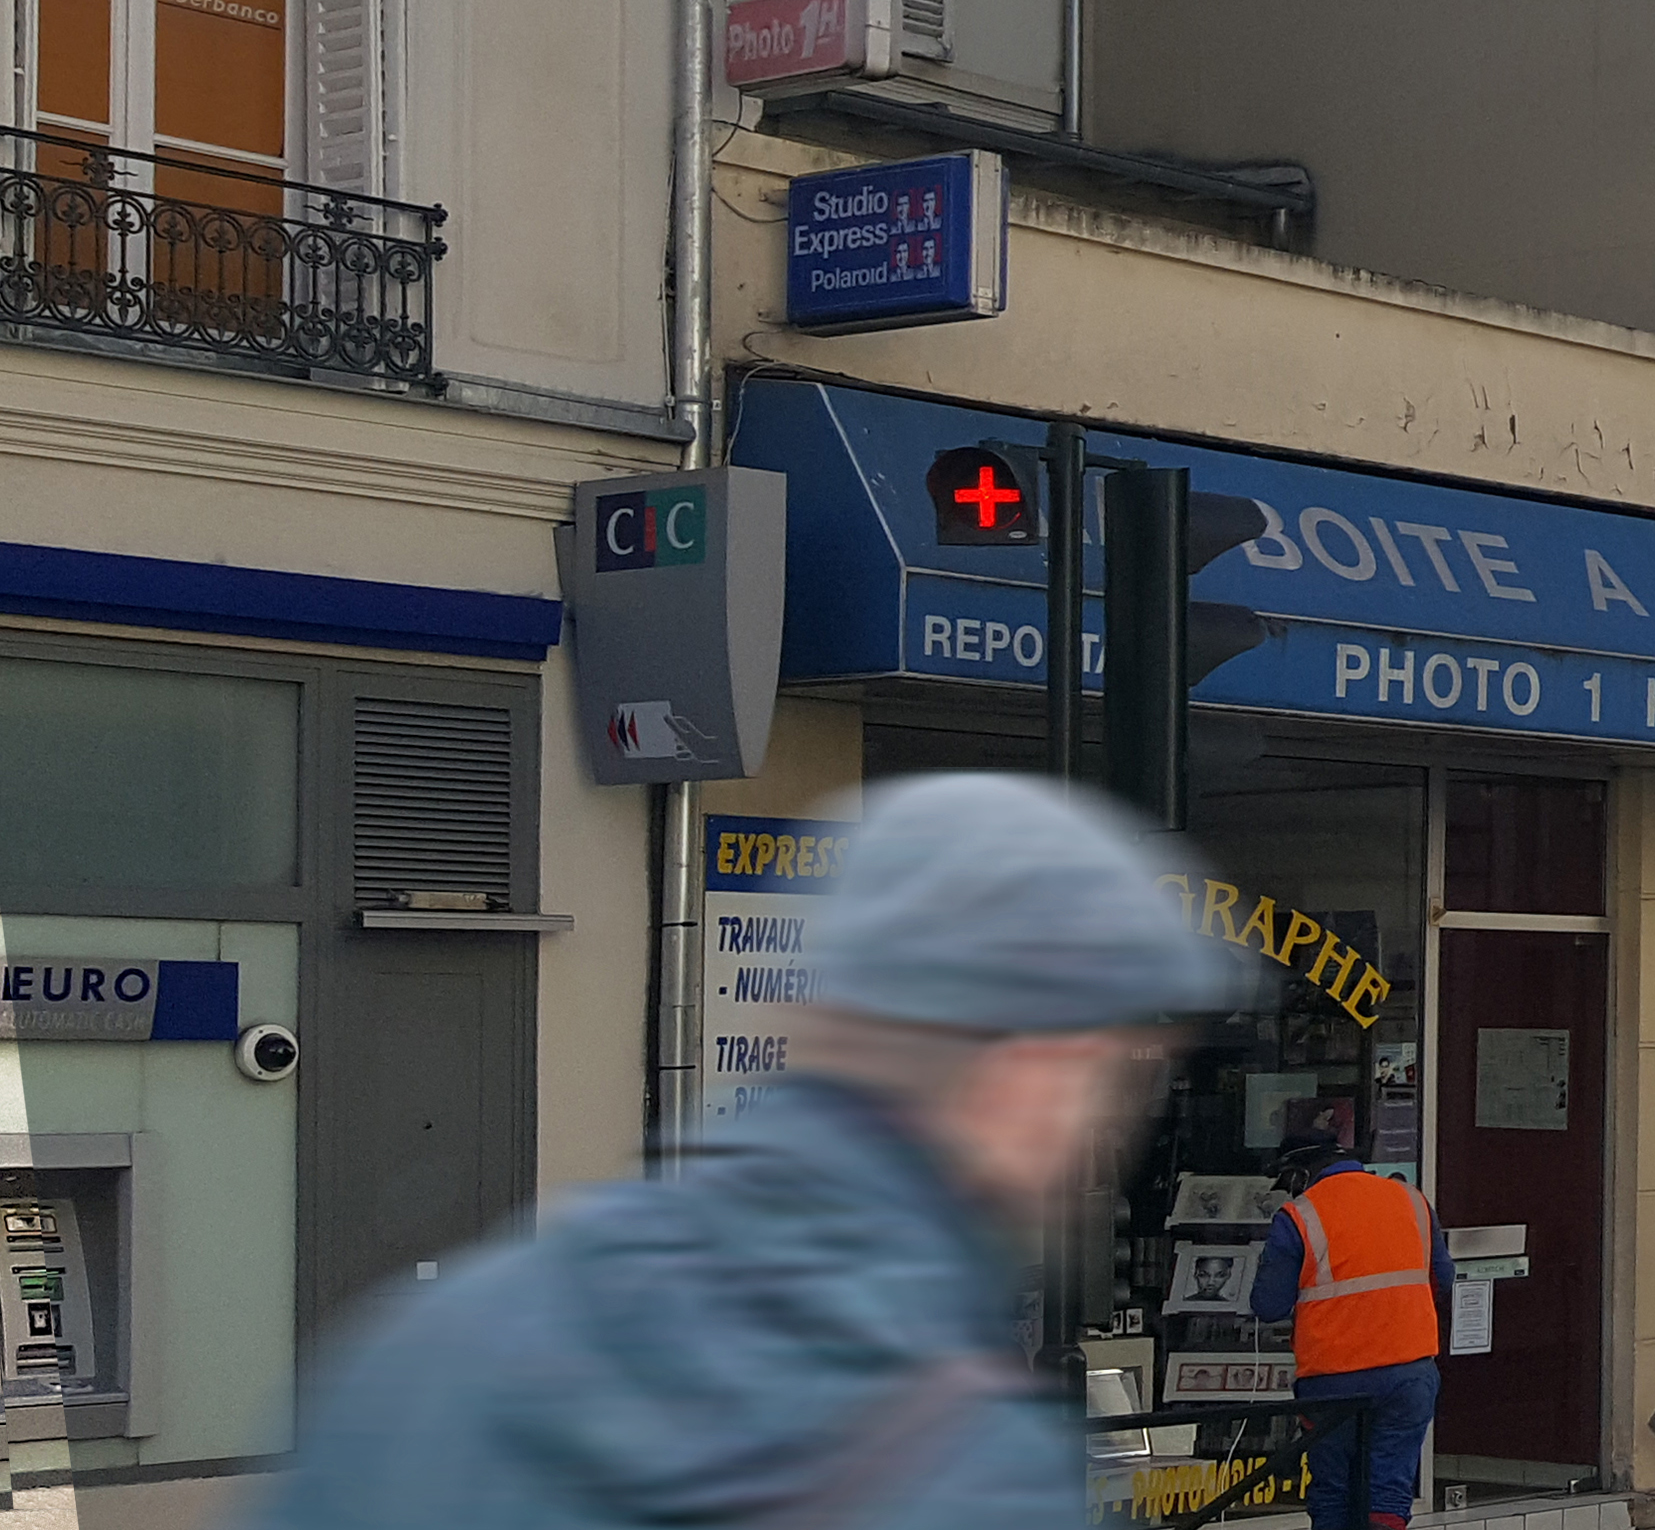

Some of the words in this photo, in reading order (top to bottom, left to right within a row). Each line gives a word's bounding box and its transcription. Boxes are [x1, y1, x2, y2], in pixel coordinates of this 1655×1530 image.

[729, 18, 795, 62] Photo
[813, 185, 888, 222] Studio
[793, 222, 888, 259] Express
[811, 261, 888, 293] Polaroid
[606, 500, 695, 556] CIC
[1242, 498, 1538, 603] BOITE
[1584, 548, 1650, 618] A
[1334, 642, 1542, 717] PHOTO
[1582, 672, 1602, 723] 1
[716, 832, 849, 879] EXPRESS
[718, 917, 805, 955] TRAVAUX
[716, 1036, 788, 1074] TIRAGE
